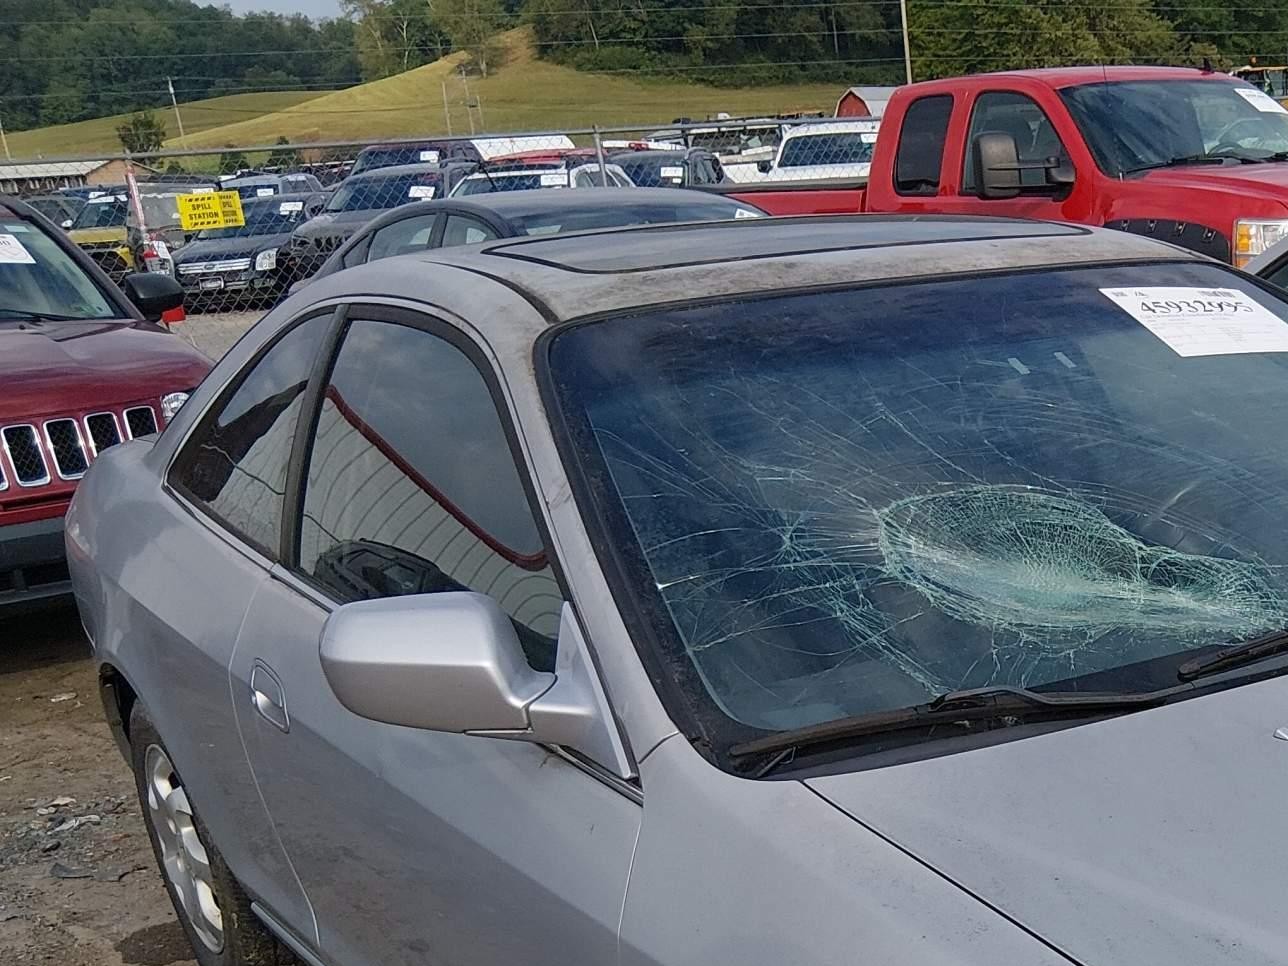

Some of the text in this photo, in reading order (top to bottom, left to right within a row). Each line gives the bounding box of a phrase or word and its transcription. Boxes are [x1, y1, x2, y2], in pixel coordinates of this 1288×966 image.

[192, 203, 211, 211] SPILL
[189, 211, 220, 221] STATION
[1141, 300, 1254, 313] 45932995
